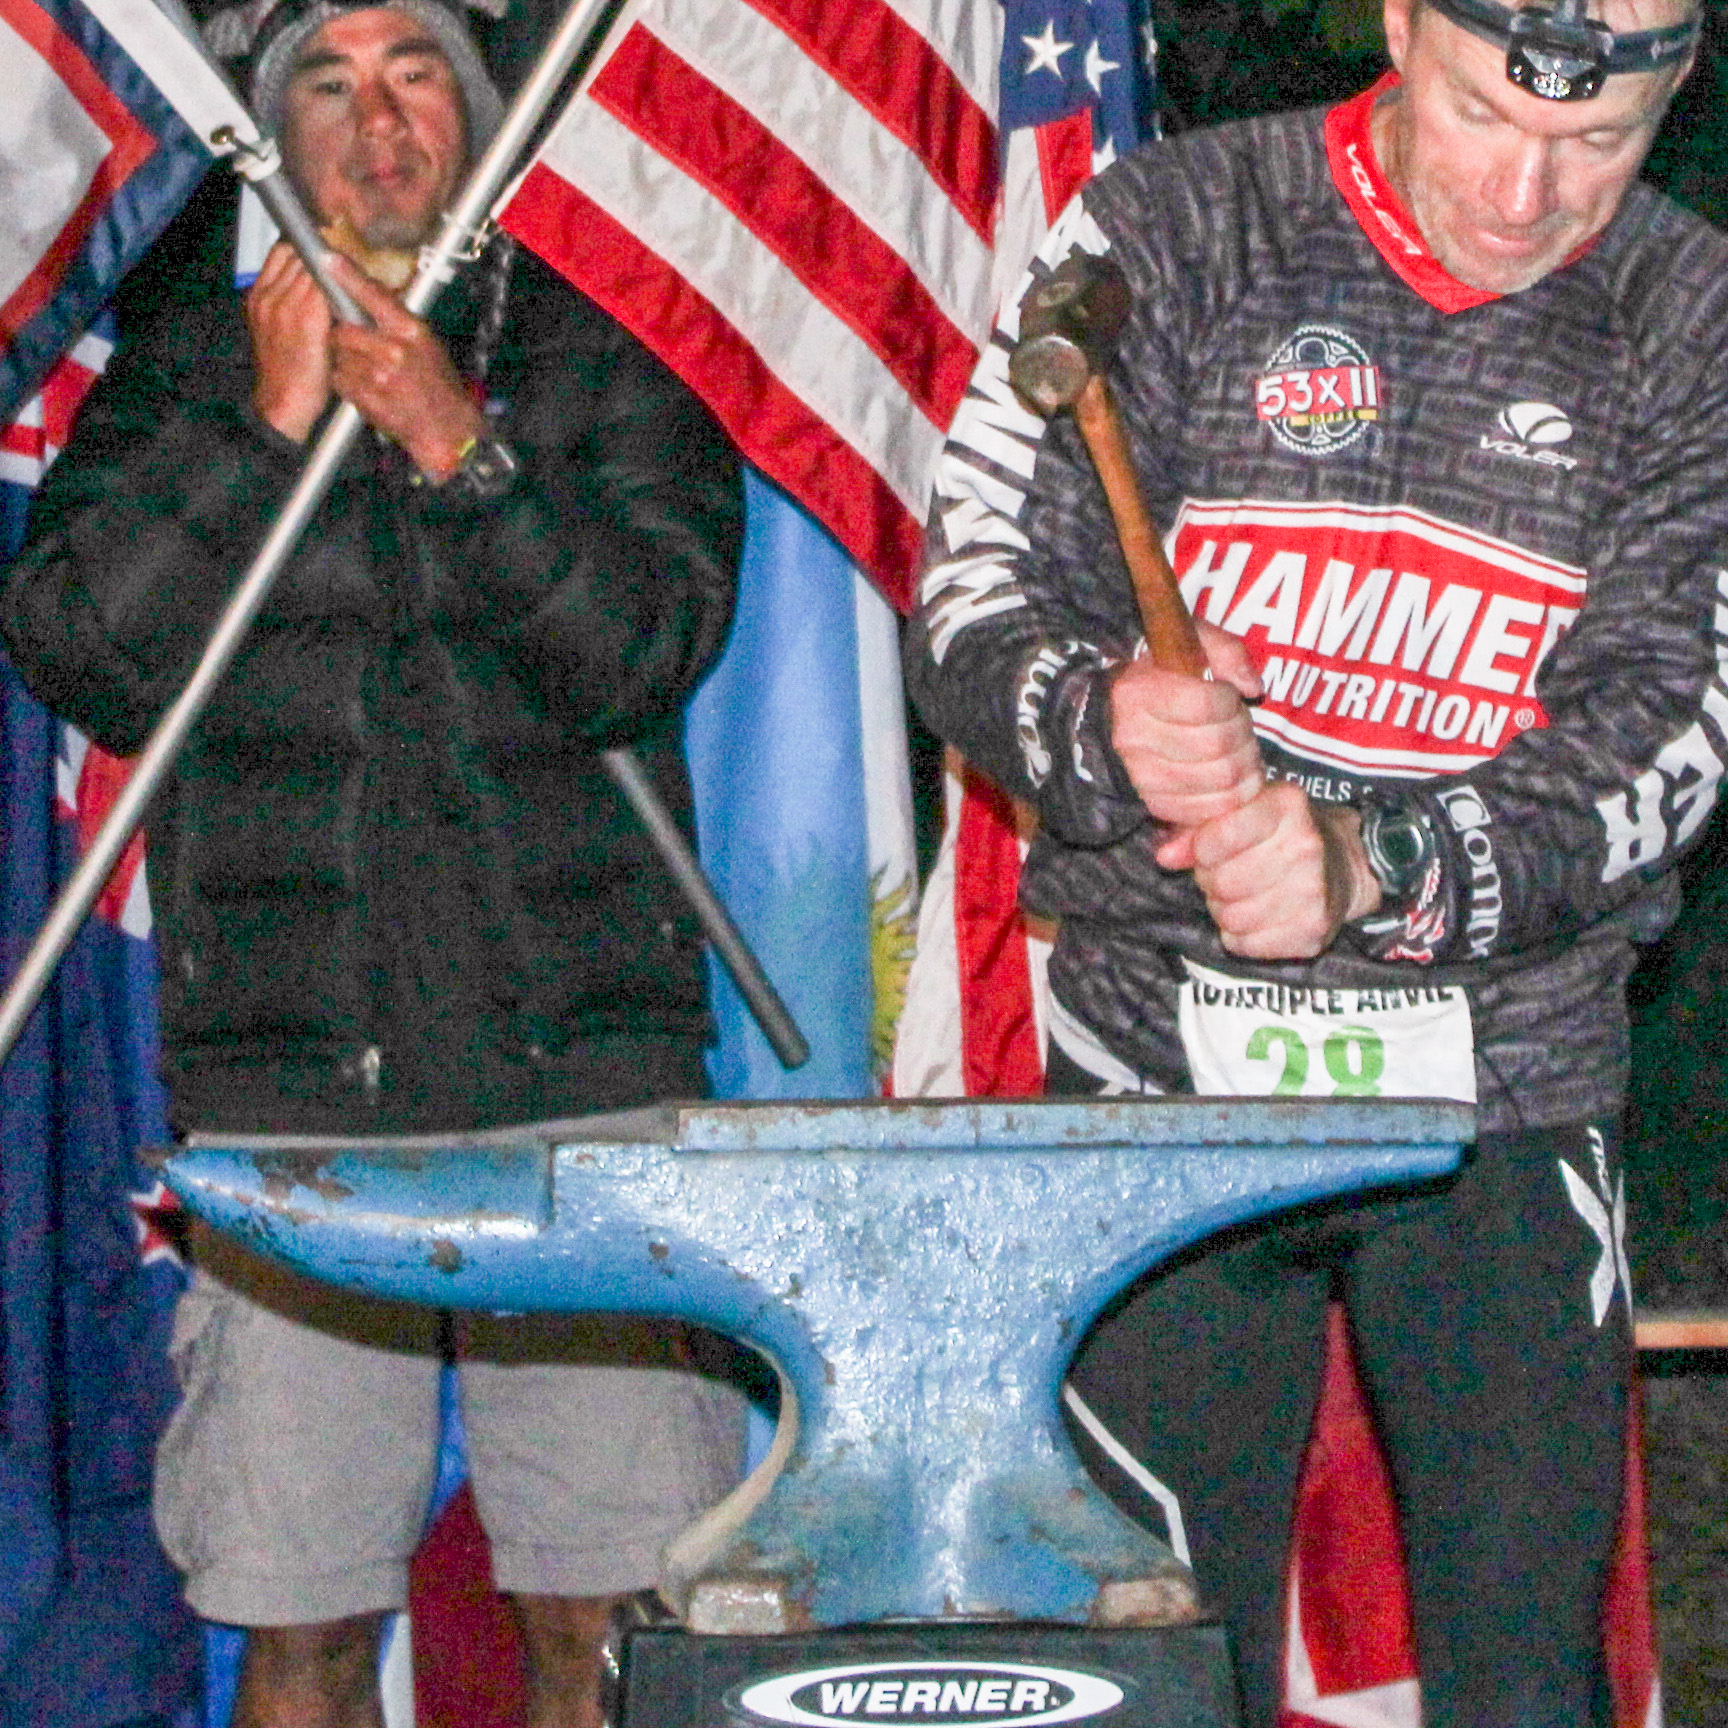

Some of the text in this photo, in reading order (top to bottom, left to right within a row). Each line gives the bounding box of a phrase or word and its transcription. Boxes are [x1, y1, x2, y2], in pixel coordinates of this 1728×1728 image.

[1479, 435, 1578, 471] VOLER
[1262, 654, 1511, 749] NUTRITION
[1245, 1024, 1385, 1098] 28
[819, 1679, 1052, 1715] WERNER
